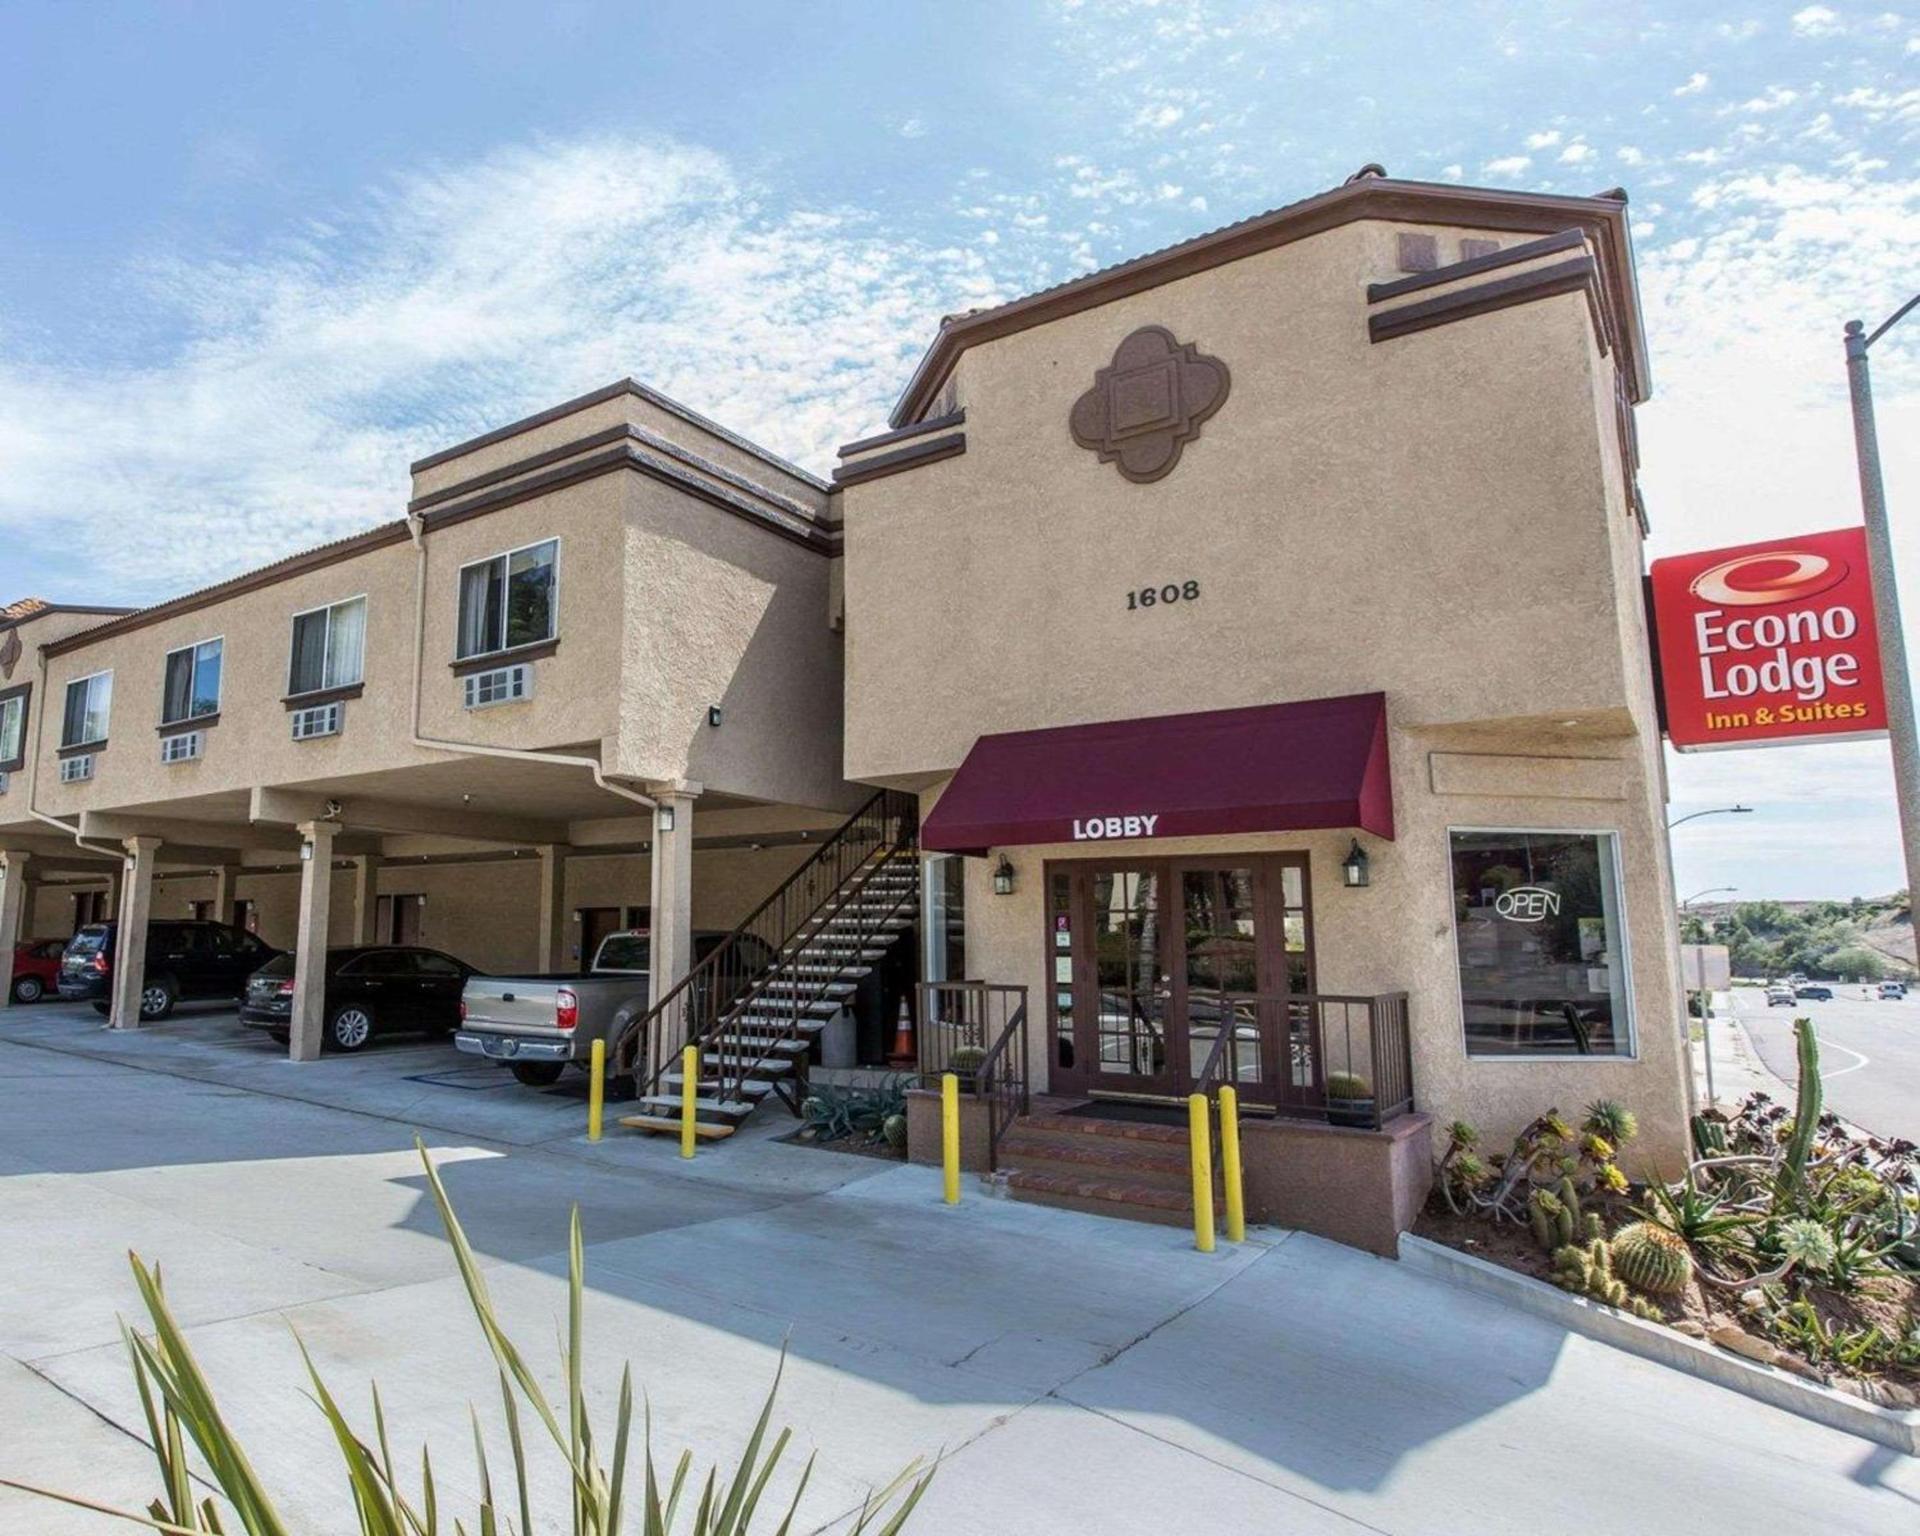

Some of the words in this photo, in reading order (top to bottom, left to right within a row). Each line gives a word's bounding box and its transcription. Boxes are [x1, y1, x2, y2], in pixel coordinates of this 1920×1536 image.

[1126, 580, 1200, 610] 1608
[1694, 606, 1857, 655] Econo
[1700, 647, 1859, 701] Lodge
[1705, 711, 1750, 730] Inn
[1755, 707, 1776, 726] &
[1779, 702, 1868, 723] Suites
[1073, 815, 1159, 840] LOBBY
[1495, 893, 1561, 916] OPEN
